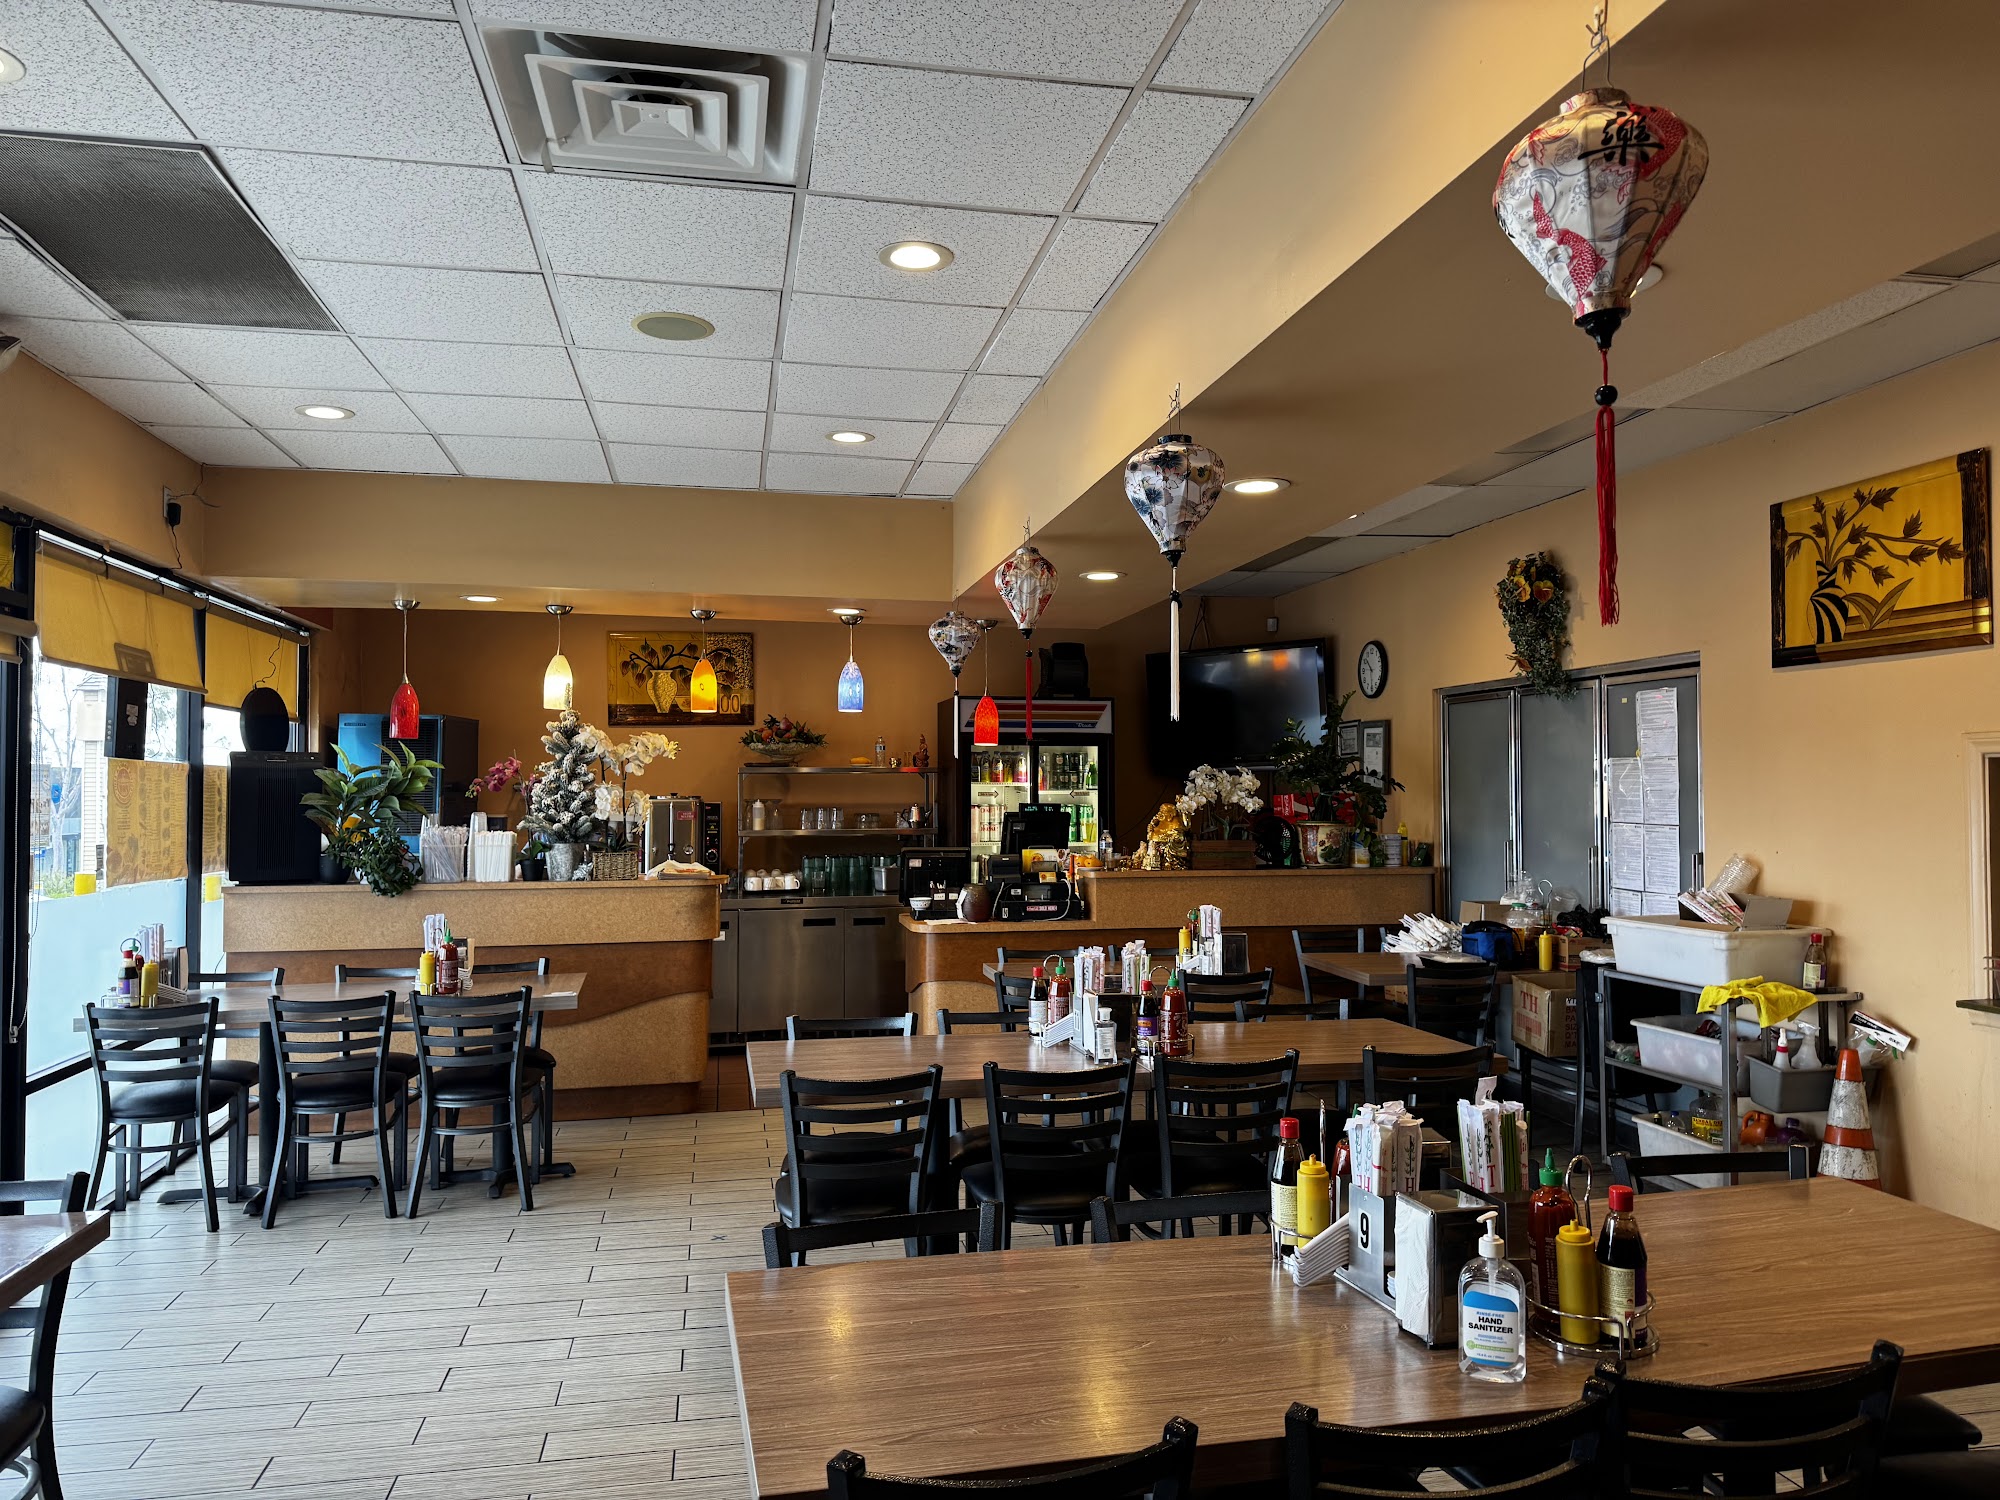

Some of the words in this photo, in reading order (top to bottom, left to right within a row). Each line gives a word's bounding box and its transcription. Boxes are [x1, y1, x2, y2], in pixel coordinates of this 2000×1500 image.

[1520, 991, 1538, 1014] TH
[1360, 1212, 1369, 1249] 9
[1468, 1322, 1513, 1334] SANITIZER
[1478, 1316, 1503, 1325] HAND
